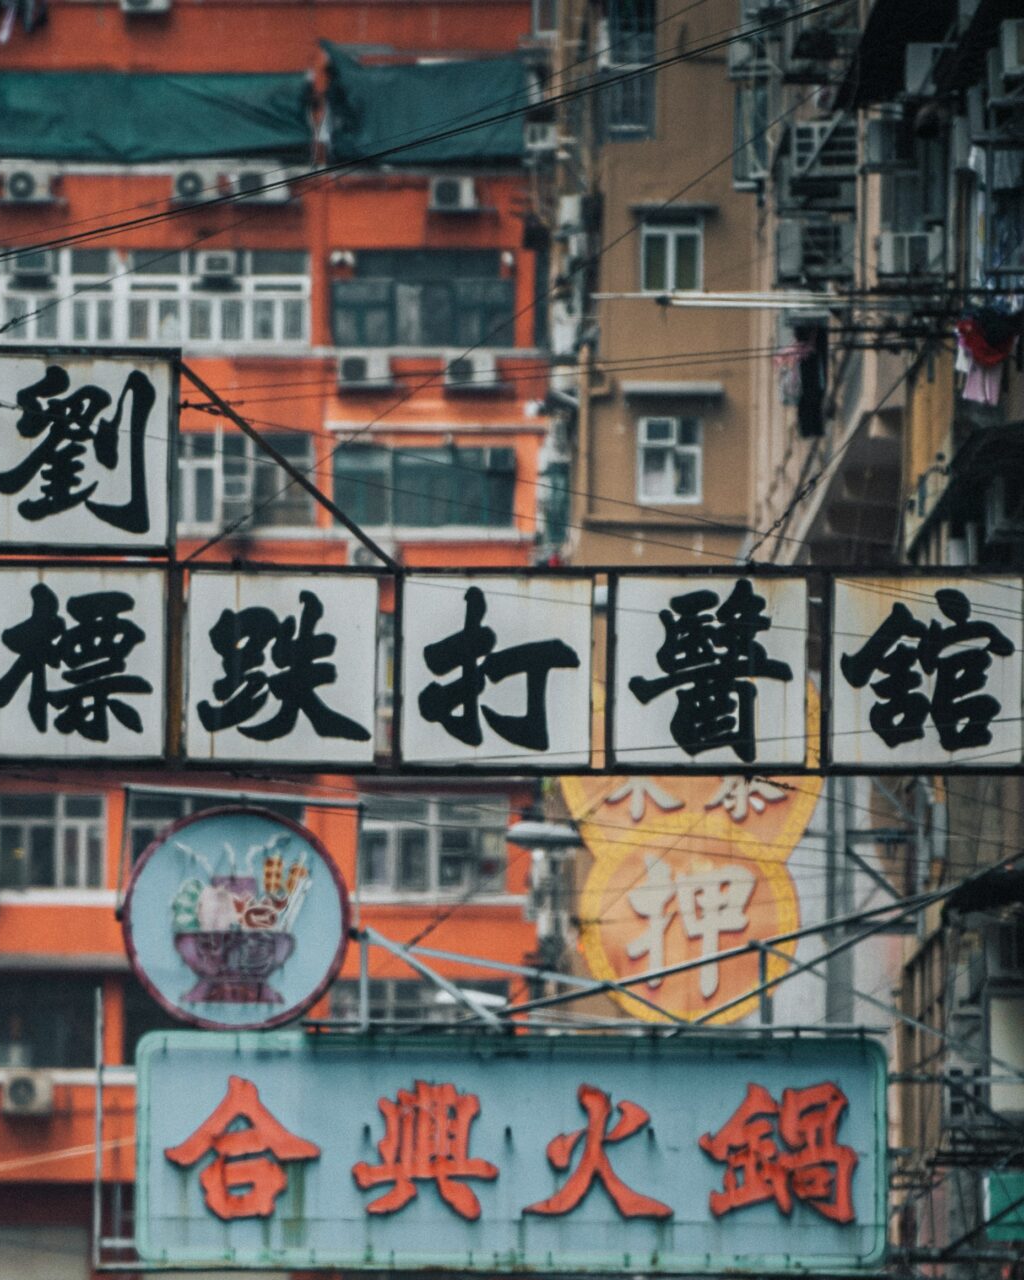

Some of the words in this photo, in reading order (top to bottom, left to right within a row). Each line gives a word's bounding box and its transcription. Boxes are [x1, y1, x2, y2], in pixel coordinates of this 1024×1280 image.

[627, 853, 758, 998] 押
[164, 1076, 859, 1224] 合興火鍋
